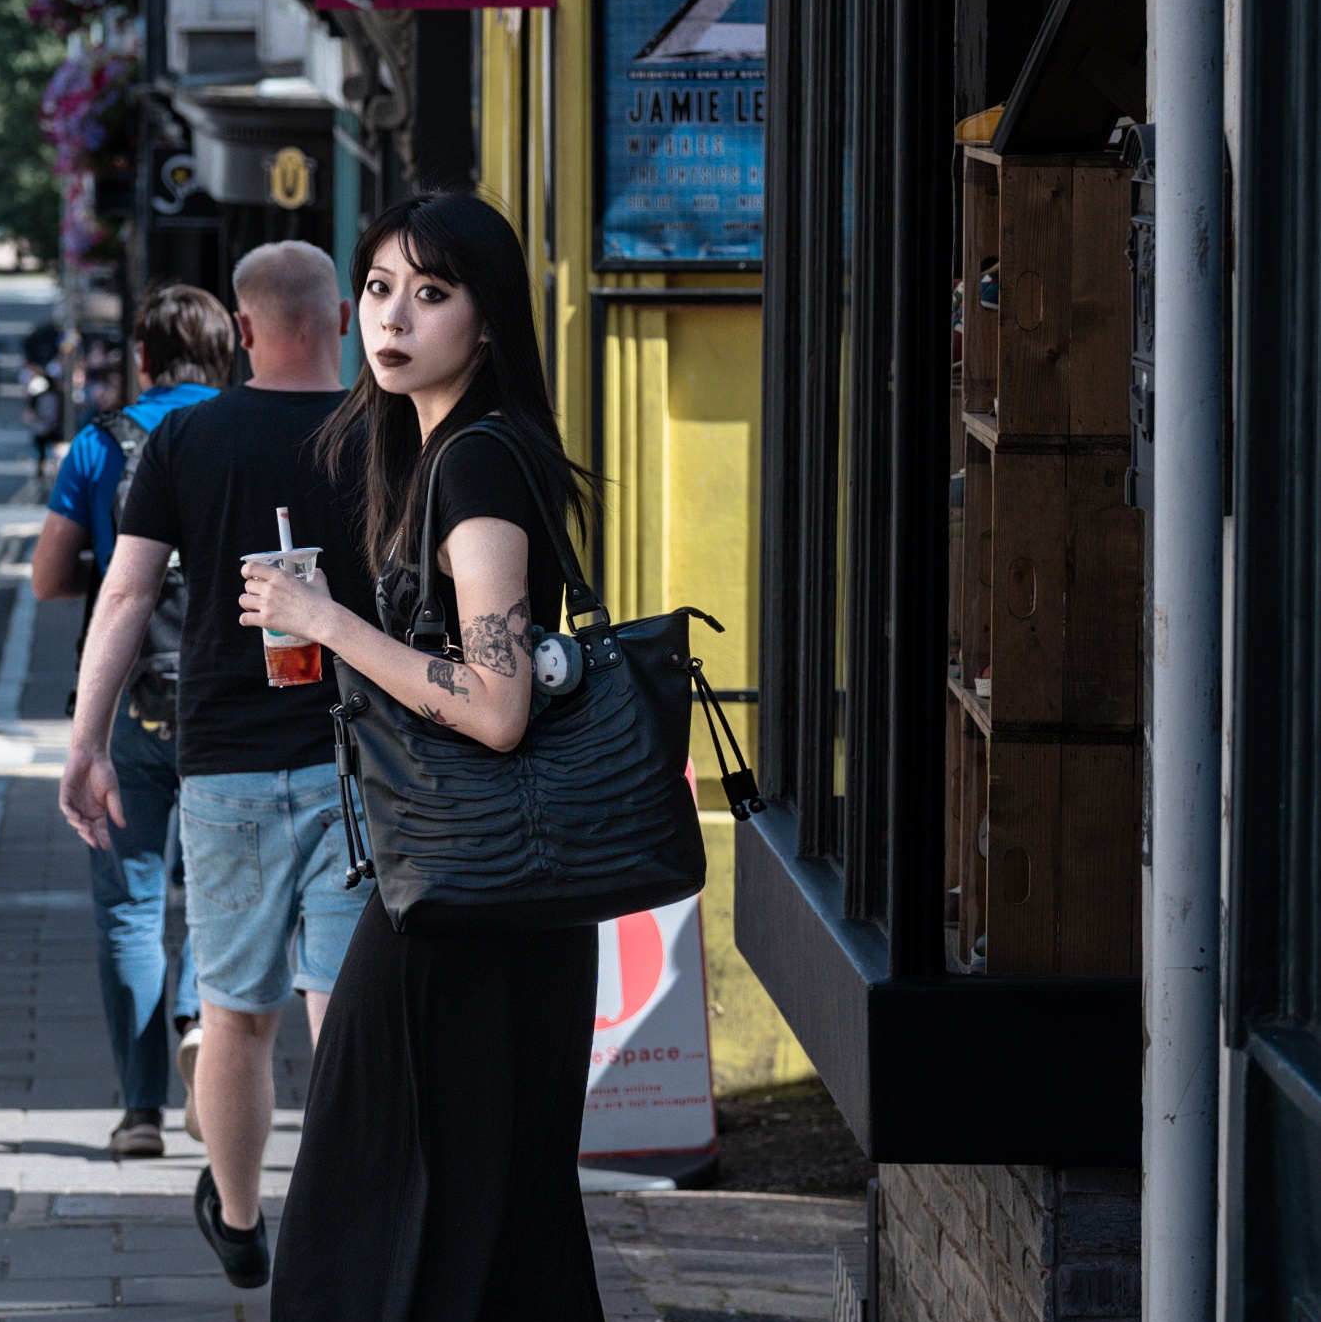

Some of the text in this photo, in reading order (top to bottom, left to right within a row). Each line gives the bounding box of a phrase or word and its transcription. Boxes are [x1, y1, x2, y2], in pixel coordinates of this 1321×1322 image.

[629, 90, 720, 123] JAMIE
[629, 165, 658, 183] THE
[667, 165, 741, 185] PHYSICS
